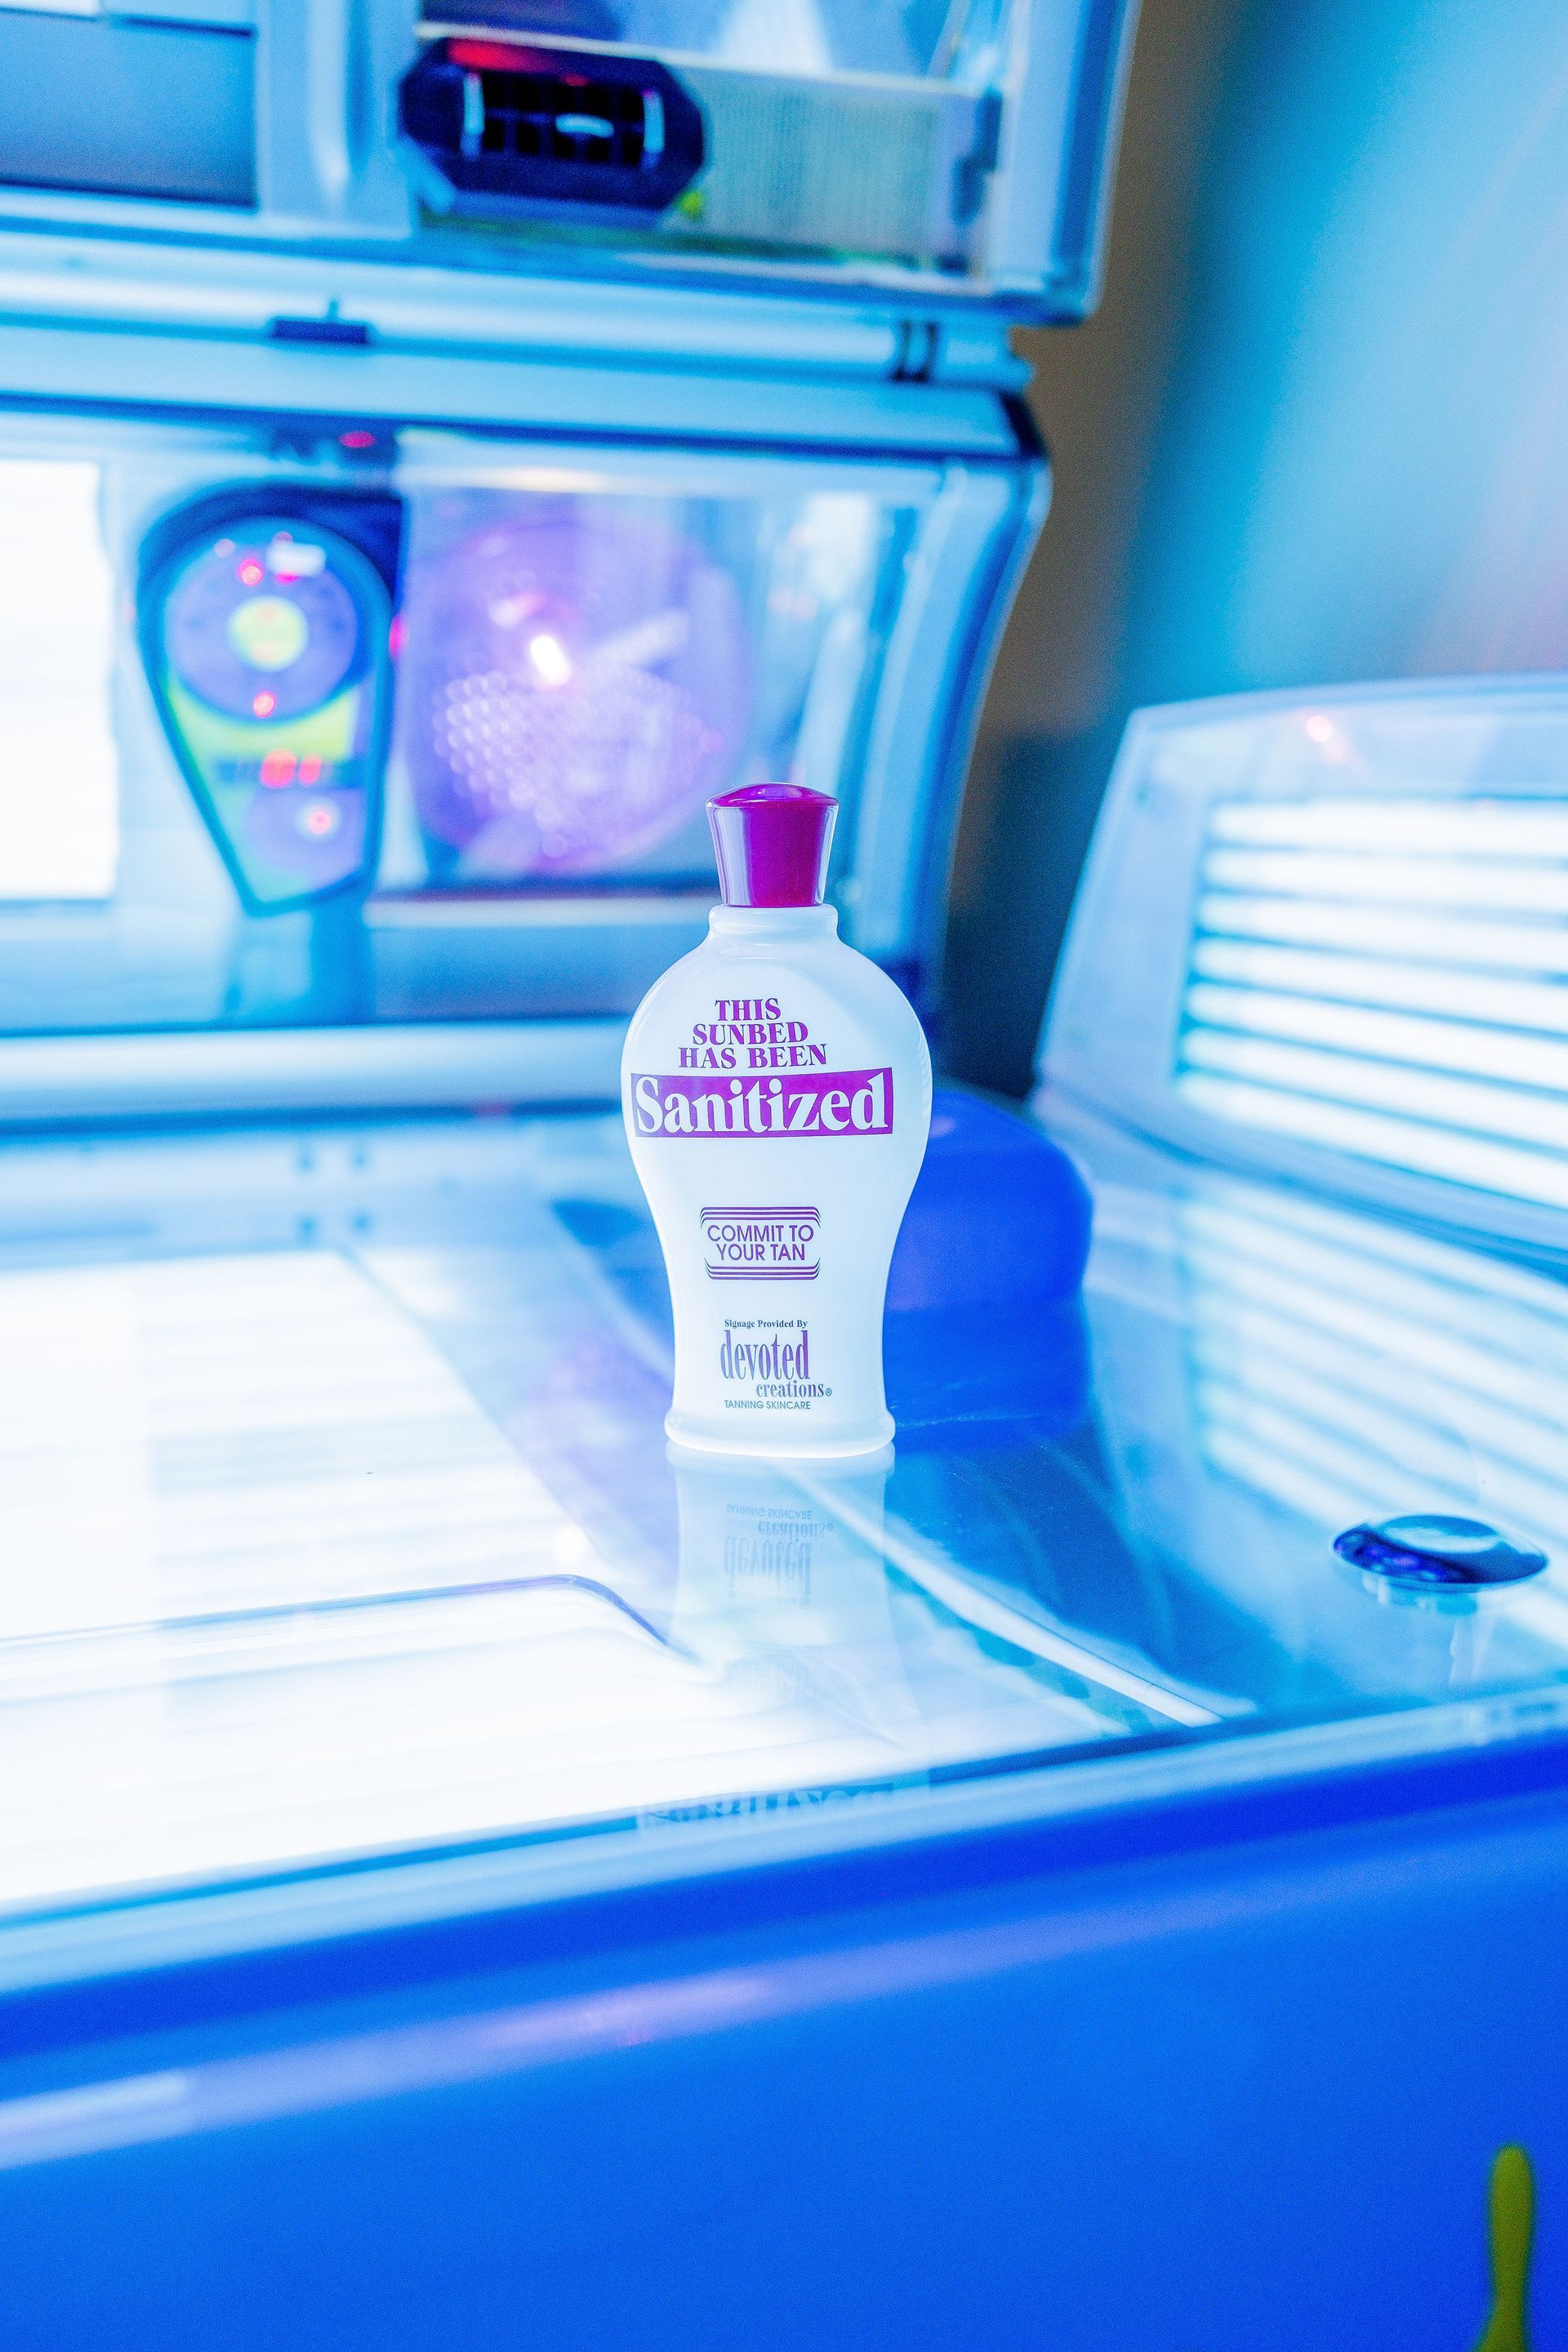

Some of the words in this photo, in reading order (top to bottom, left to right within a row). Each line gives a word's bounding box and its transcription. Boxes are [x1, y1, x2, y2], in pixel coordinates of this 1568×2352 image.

[715, 997, 782, 1022] THIS
[693, 1021, 809, 1045] SUNBED
[678, 1047, 737, 1069] HAS
[747, 1044, 827, 1069] BEEN
[635, 1071, 889, 1134] Sanitized
[707, 1224, 785, 1242] COMMIT
[789, 1224, 814, 1242] TO
[716, 1244, 766, 1261] YOUR
[770, 1244, 805, 1261] TAN
[724, 1319, 755, 1330] Signage
[758, 1319, 794, 1328] Provided
[797, 1320, 808, 1330] By
[720, 1330, 811, 1380] devoted
[724, 1400, 764, 1410] TANNING
[766, 1401, 811, 1410] SKINCARE
